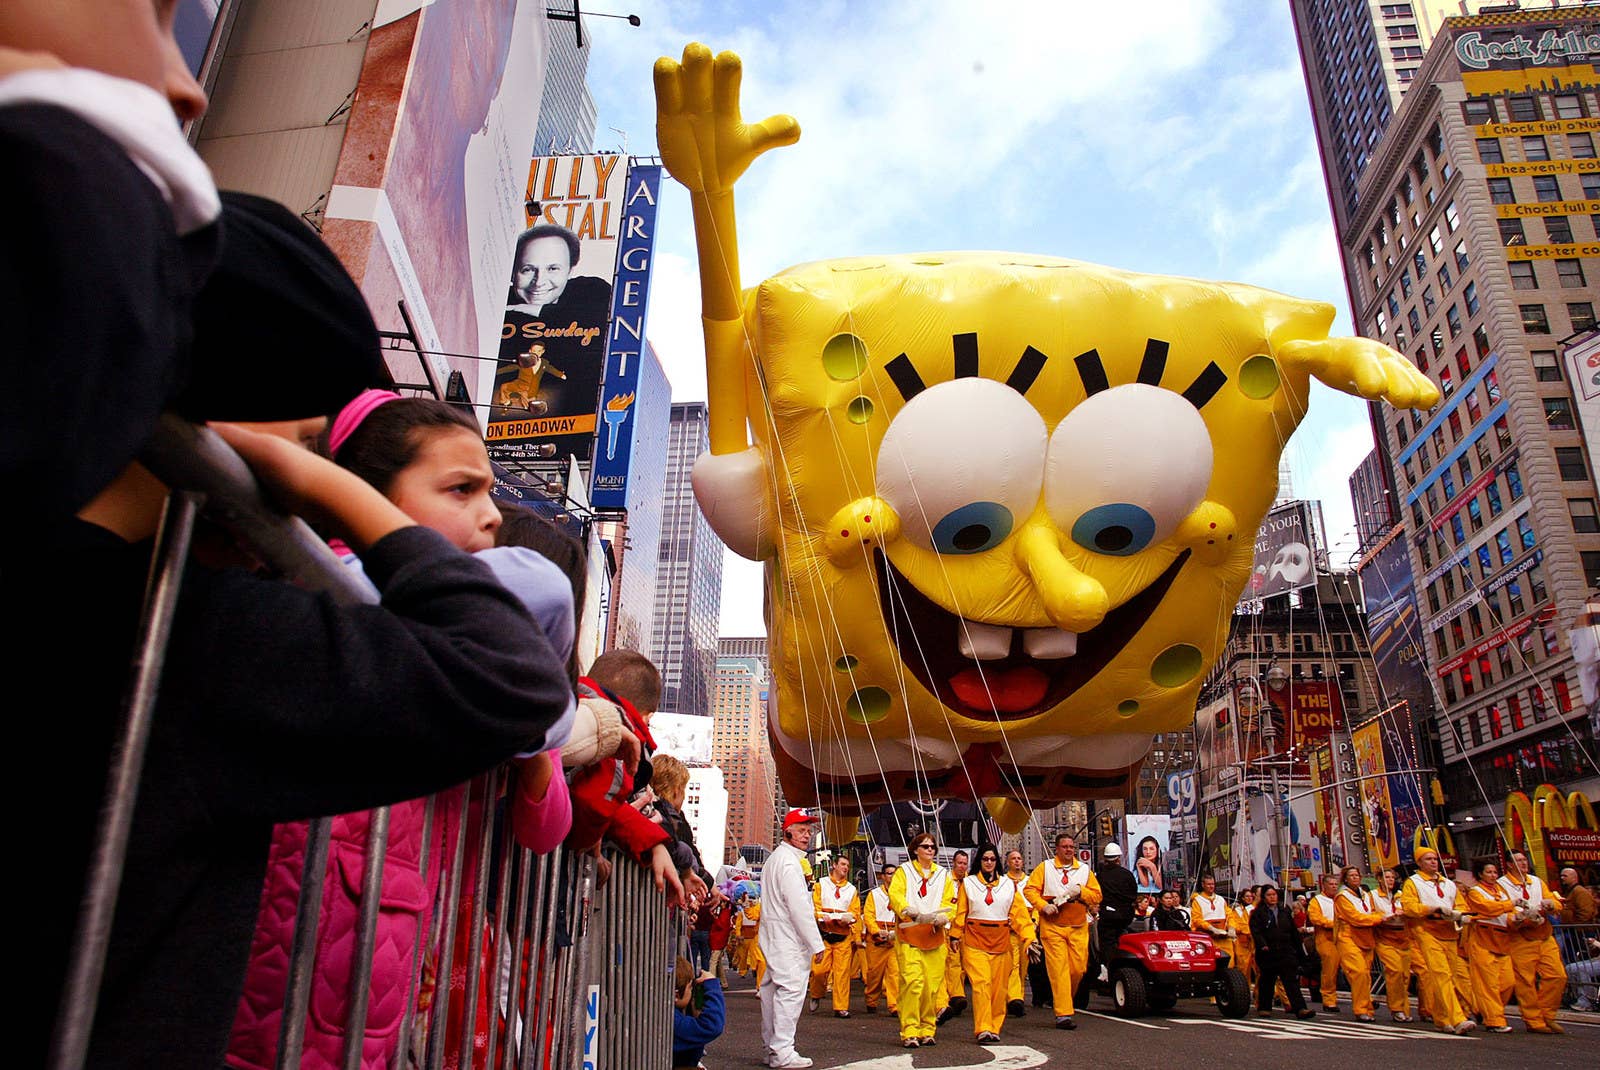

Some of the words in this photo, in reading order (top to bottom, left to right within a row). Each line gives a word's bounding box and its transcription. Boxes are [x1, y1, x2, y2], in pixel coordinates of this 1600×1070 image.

[1455, 31, 1533, 69] Chock
[1493, 125, 1535, 135] Chock
[1539, 123, 1562, 132] full
[1502, 162, 1573, 174] hea-ven-ly
[1515, 204, 1559, 215] Chock
[1562, 202, 1586, 212] full
[1524, 247, 1577, 257] bet-ter
[609, 179, 656, 378] ARGENT
[521, 321, 600, 346] Sundays
[487, 426, 503, 438] ON
[507, 419, 577, 436] BROADWAY
[595, 474, 625, 484] ARGENT
[1269, 514, 1301, 534] YOUR
[1488, 557, 1535, 593] mattress.com
[1298, 694, 1329, 708] THE
[1293, 709, 1335, 732] LION
[1339, 742, 1361, 845] PALACE
